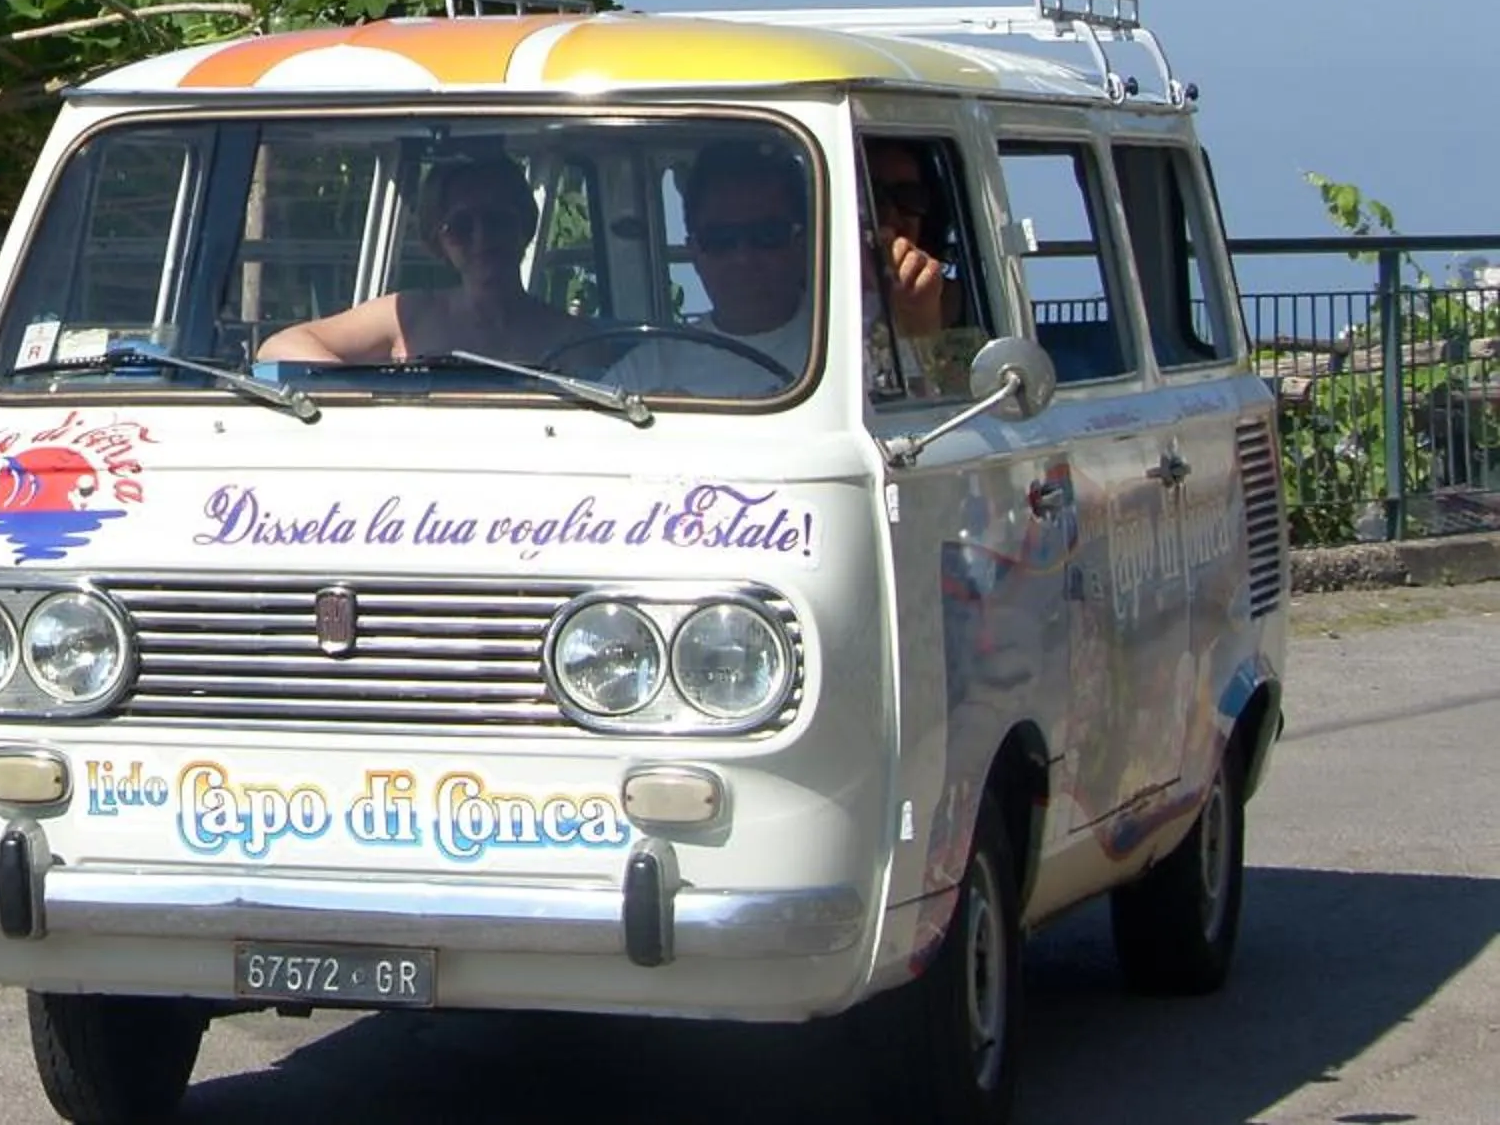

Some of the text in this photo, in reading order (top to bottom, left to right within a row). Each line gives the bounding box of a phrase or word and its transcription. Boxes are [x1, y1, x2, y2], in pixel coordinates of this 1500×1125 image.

[193, 484, 812, 560] Disseta la tua voglia d'Estate!
[86, 760, 630, 863] Lido Capo di Conca
[248, 955, 417, 994] 67572 GR
